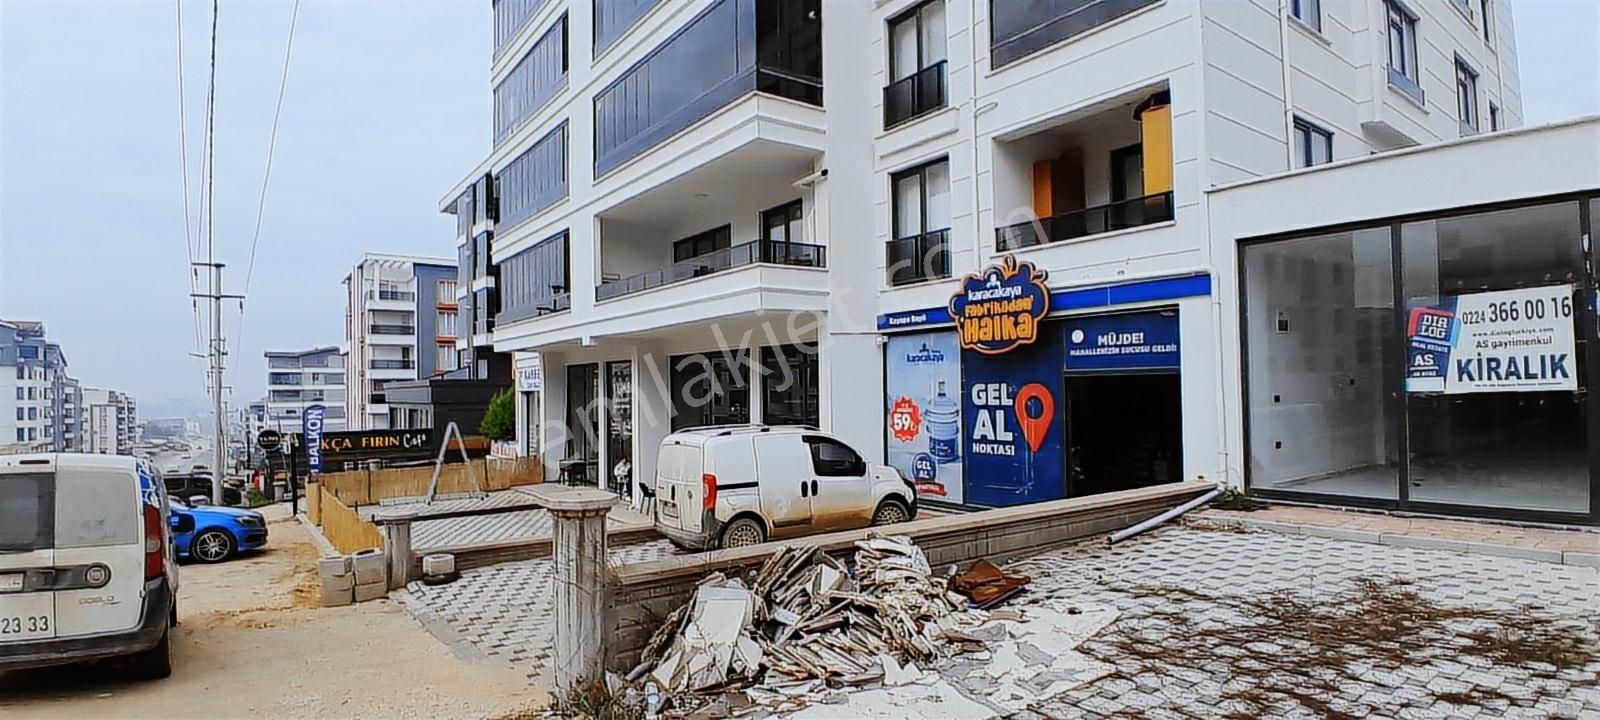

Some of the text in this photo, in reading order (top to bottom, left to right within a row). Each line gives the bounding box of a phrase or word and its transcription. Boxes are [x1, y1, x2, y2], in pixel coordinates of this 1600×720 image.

[968, 286, 1022, 301] karacakaya
[1462, 296, 1572, 325] 0224 366 00 16
[1097, 331, 1144, 346] MÜJDE!
[1420, 326, 1446, 339] LOG
[1476, 335, 1553, 350] AS gayrimenkul
[1414, 354, 1434, 366] AS
[1456, 352, 1570, 382] KİRALIK
[971, 383, 1014, 406] GEL
[973, 408, 1013, 441] AL
[308, 409, 323, 465] BALKON
[320, 437, 352, 452] KÇA
[361, 436, 400, 448] FIRIN
[972, 442, 1015, 456] NOKTASI
[917, 460, 932, 470] GEL
[2, 615, 49, 634] 23 33
